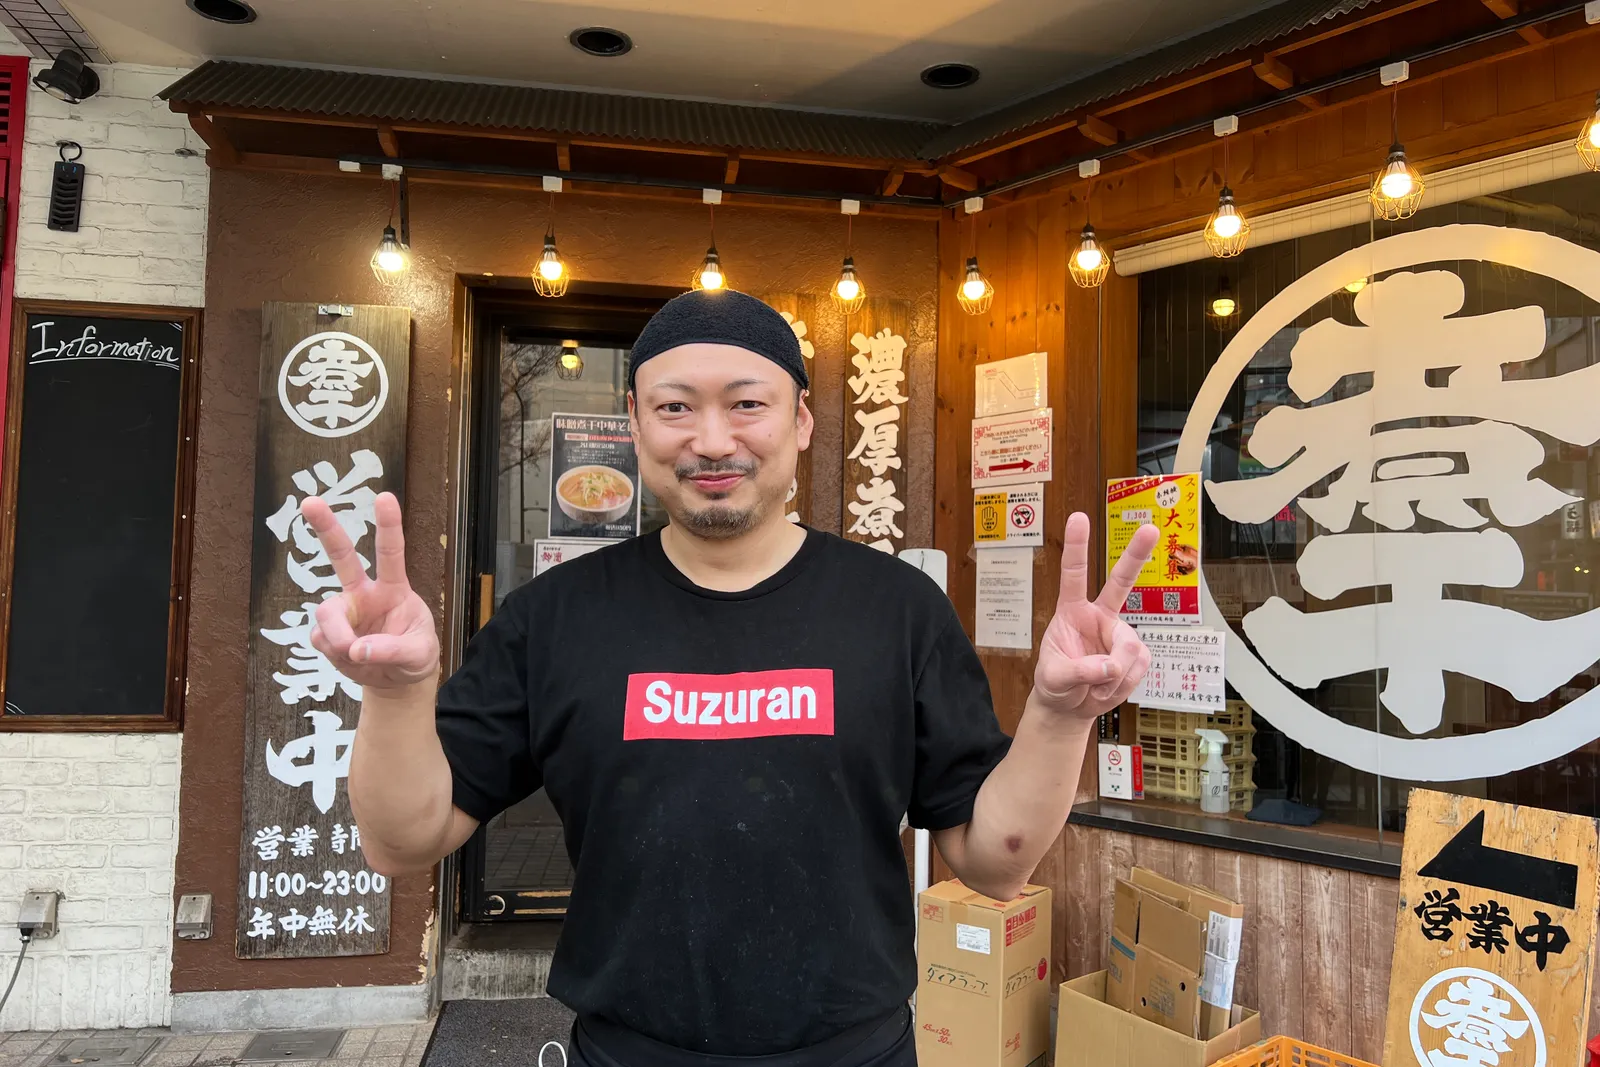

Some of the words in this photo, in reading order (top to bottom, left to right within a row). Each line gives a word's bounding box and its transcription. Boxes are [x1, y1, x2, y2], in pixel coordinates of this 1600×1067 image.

[31, 321, 180, 362] Information
[1156, 486, 1178, 499] 未経験
[1162, 497, 1175, 507] OK
[1185, 477, 1196, 532] スタッフ
[1163, 507, 1183, 581] 大募集
[1181, 672, 1198, 682] 休業
[1181, 682, 1198, 692] 休業
[643, 680, 817, 725] Suzuran
[246, 905, 376, 940] 年中無休
[1413, 887, 1571, 972] 営業中
